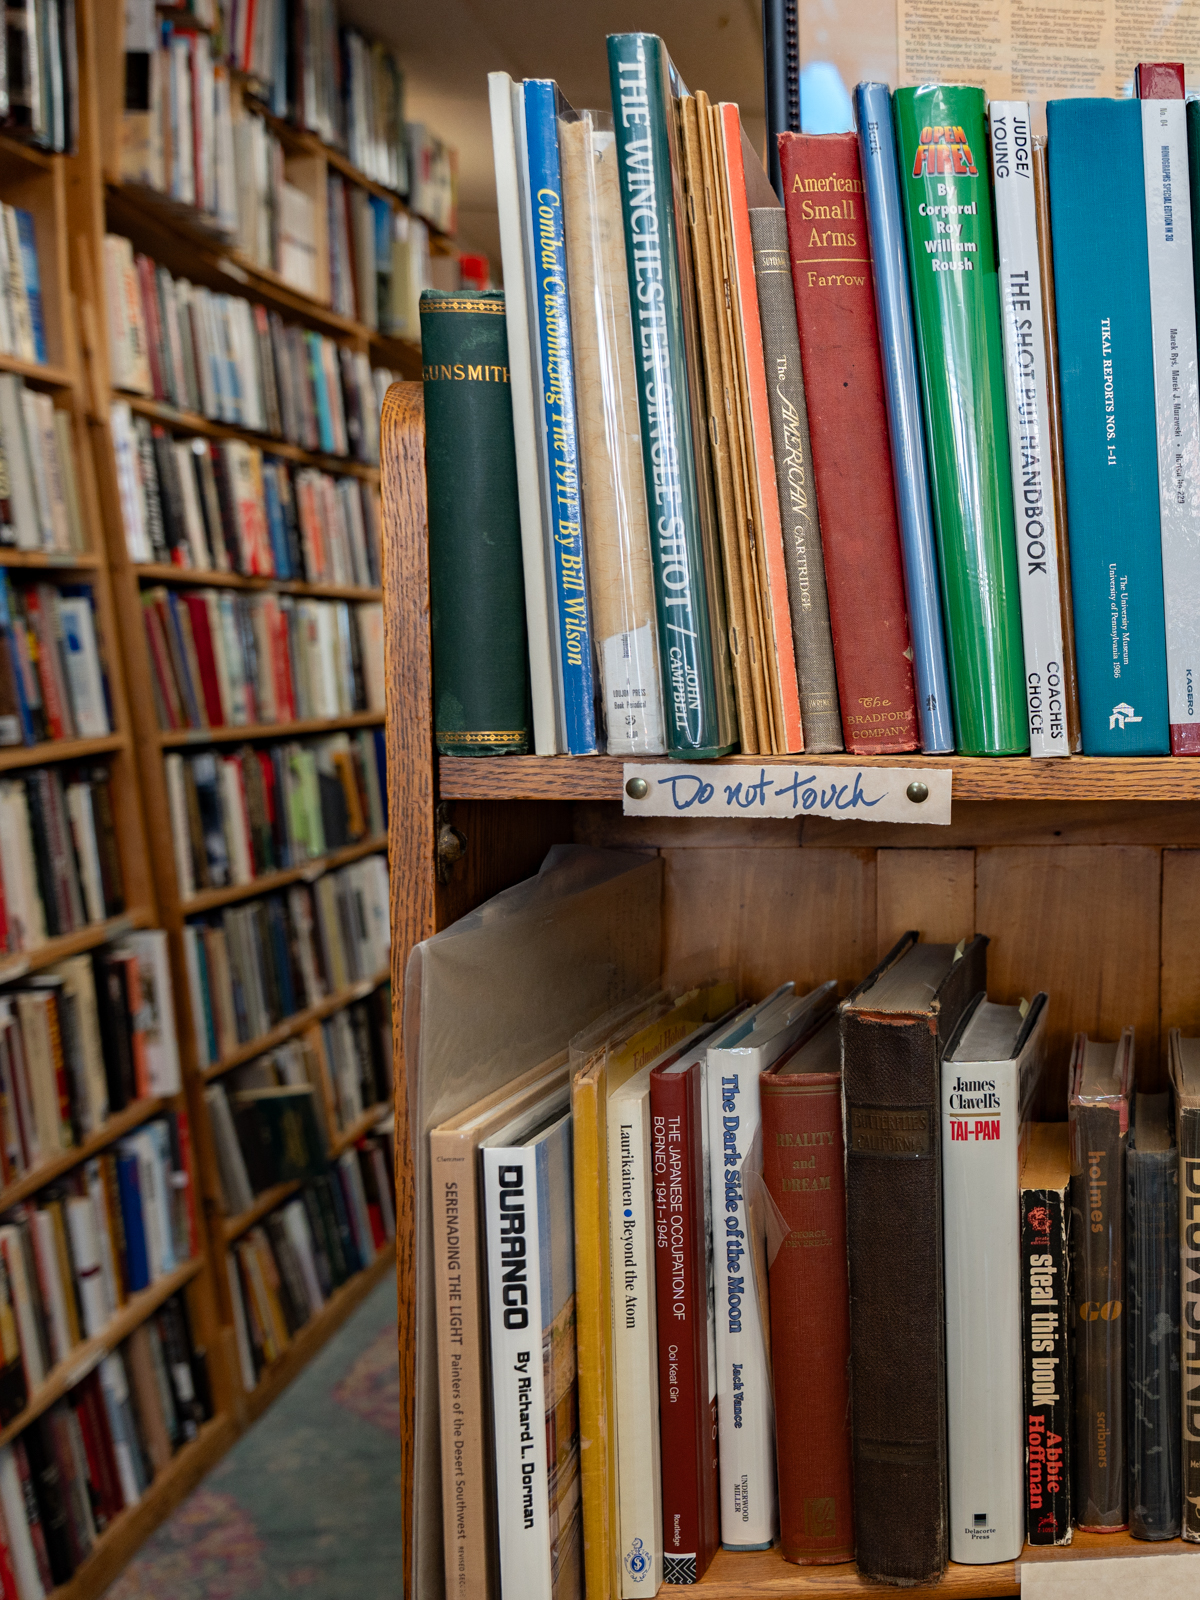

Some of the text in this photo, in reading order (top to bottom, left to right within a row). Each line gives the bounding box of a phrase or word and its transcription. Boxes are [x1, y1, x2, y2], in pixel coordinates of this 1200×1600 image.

[993, 117, 1009, 178] YOUNG
[1013, 117, 1030, 178] JUDGE/
[792, 172, 866, 194] American
[938, 184, 956, 198] By
[802, 200, 856, 220] Small
[918, 202, 977, 216] Corporal
[936, 221, 962, 236] Roy
[808, 228, 857, 248] Arms
[924, 239, 977, 253] William
[807, 272, 865, 287] Farrow
[932, 257, 974, 272] Roush
[542, 277, 573, 404] Customizing
[619, 60, 691, 612] THE WINCHESTER SINGLE SHOT
[1101, 318, 1114, 412] TIKAL REPORTS
[1010, 270, 1046, 576] THE SHOT HANDBOOK
[1170, 370, 1182, 437] Marek Murawski
[794, 526, 811, 612] CARTRIDGE
[1108, 564, 1122, 678] University 1986
[1119, 575, 1131, 665] The University Museum
[669, 647, 688, 730] CAMPBELL
[858, 696, 892, 708] The
[1028, 673, 1044, 735] CHOICE
[1045, 662, 1062, 739] COACHES
[1185, 668, 1194, 716] KAGERO
[658, 774, 714, 810] Do
[724, 768, 774, 809] not
[950, 1093, 1000, 1110] Clavell's
[953, 1076, 996, 1092] James
[950, 1120, 1000, 1141] TAI-PAN
[620, 1124, 636, 1267] Laurikainen Beyond
[669, 1146, 684, 1300] JAPANESE OCCUPATION
[722, 1116, 746, 1334] Dark Side Moon
[446, 1182, 463, 1346] SERENADING LIGHT
[1030, 1254, 1058, 1306] steal
[499, 1164, 536, 1530] DURANGO Richard Dorman
[1031, 1312, 1059, 1352] this
[670, 1386, 680, 1403] Gin
[1032, 1358, 1060, 1406] book
[1028, 1414, 1046, 1510] Hoffman
[1046, 1430, 1062, 1494] Abbie
[734, 1484, 742, 1513] MILLER
[740, 1474, 750, 1522] UNDERWOOD
[672, 1514, 681, 1546] Routledge
